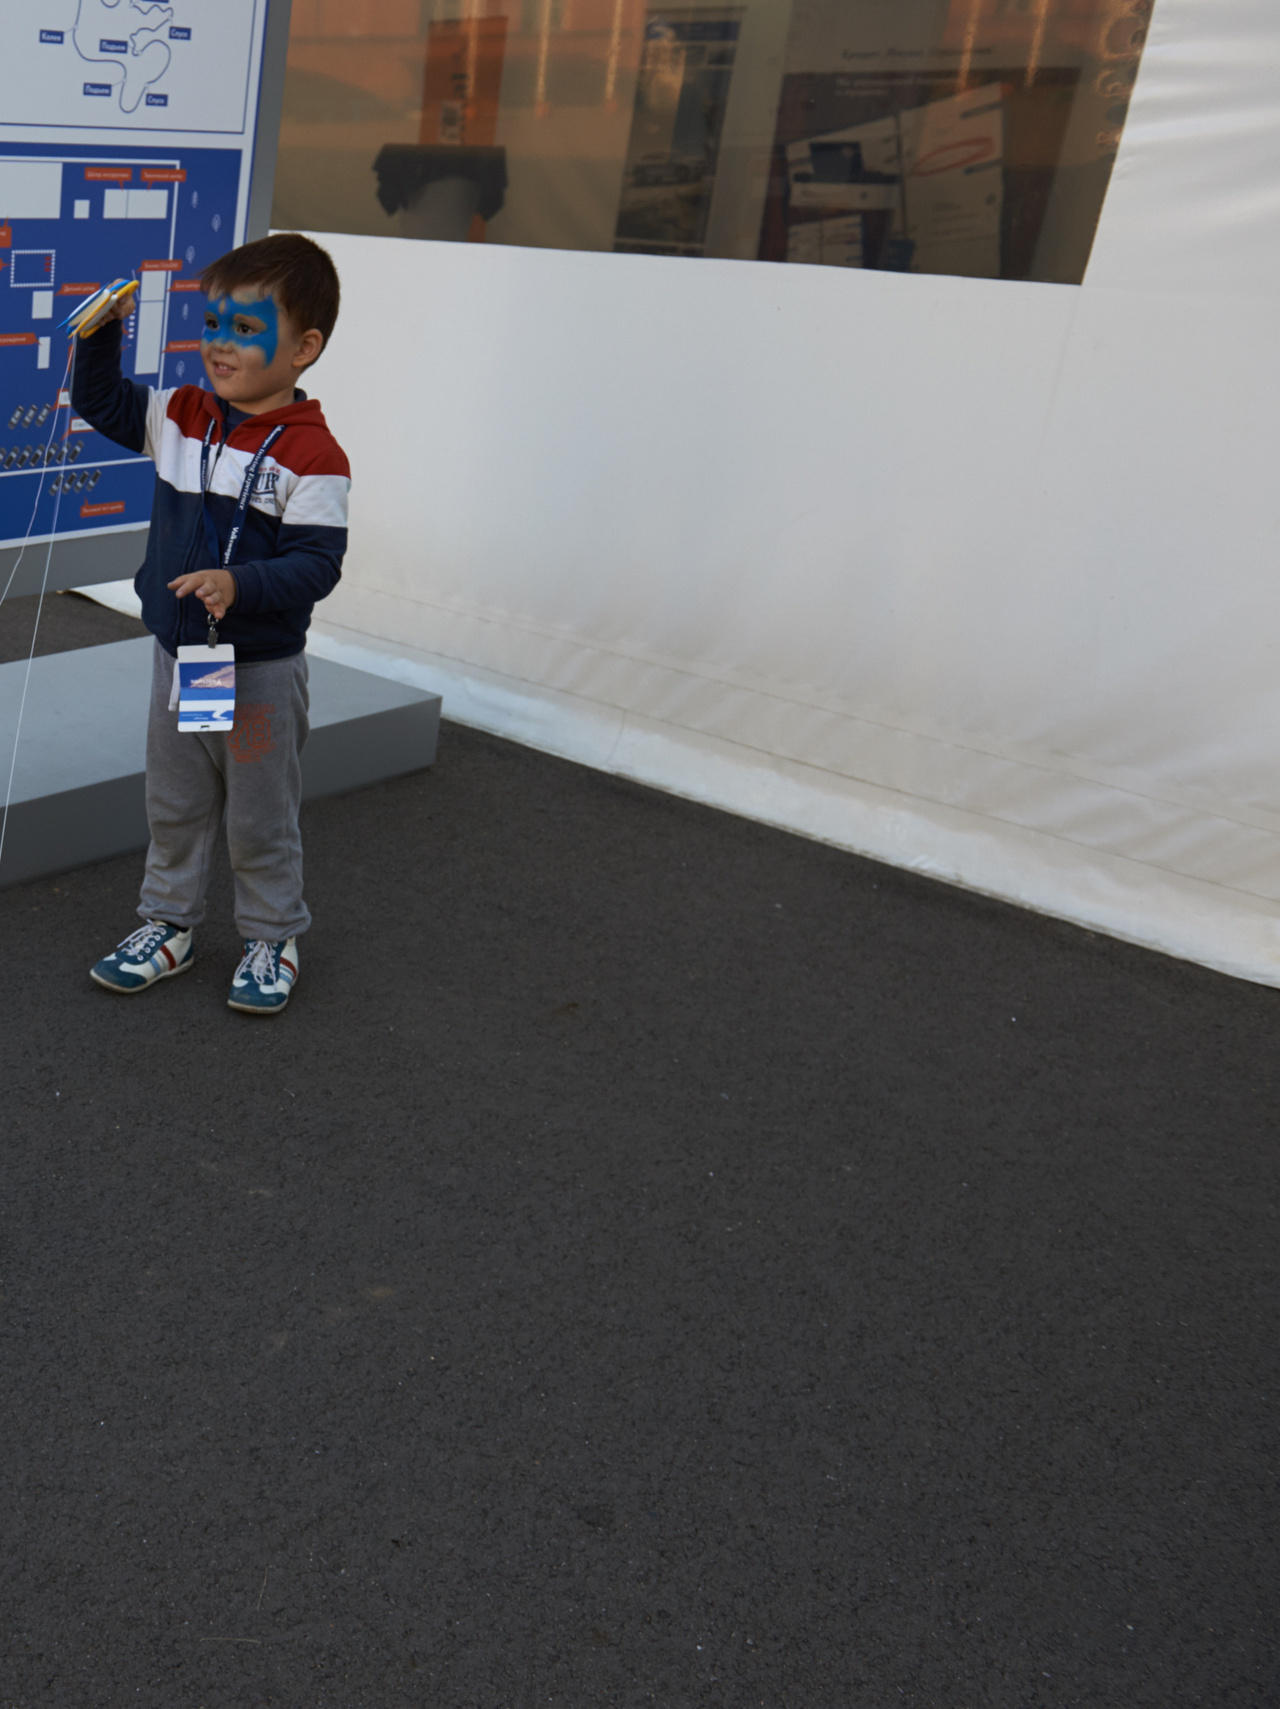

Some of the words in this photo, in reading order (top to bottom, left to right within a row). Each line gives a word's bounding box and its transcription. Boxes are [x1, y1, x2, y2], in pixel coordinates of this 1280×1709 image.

[248, 448, 265, 475] Driving
[239, 472, 255, 510] Experience
[224, 526, 240, 565] Volkswagen
